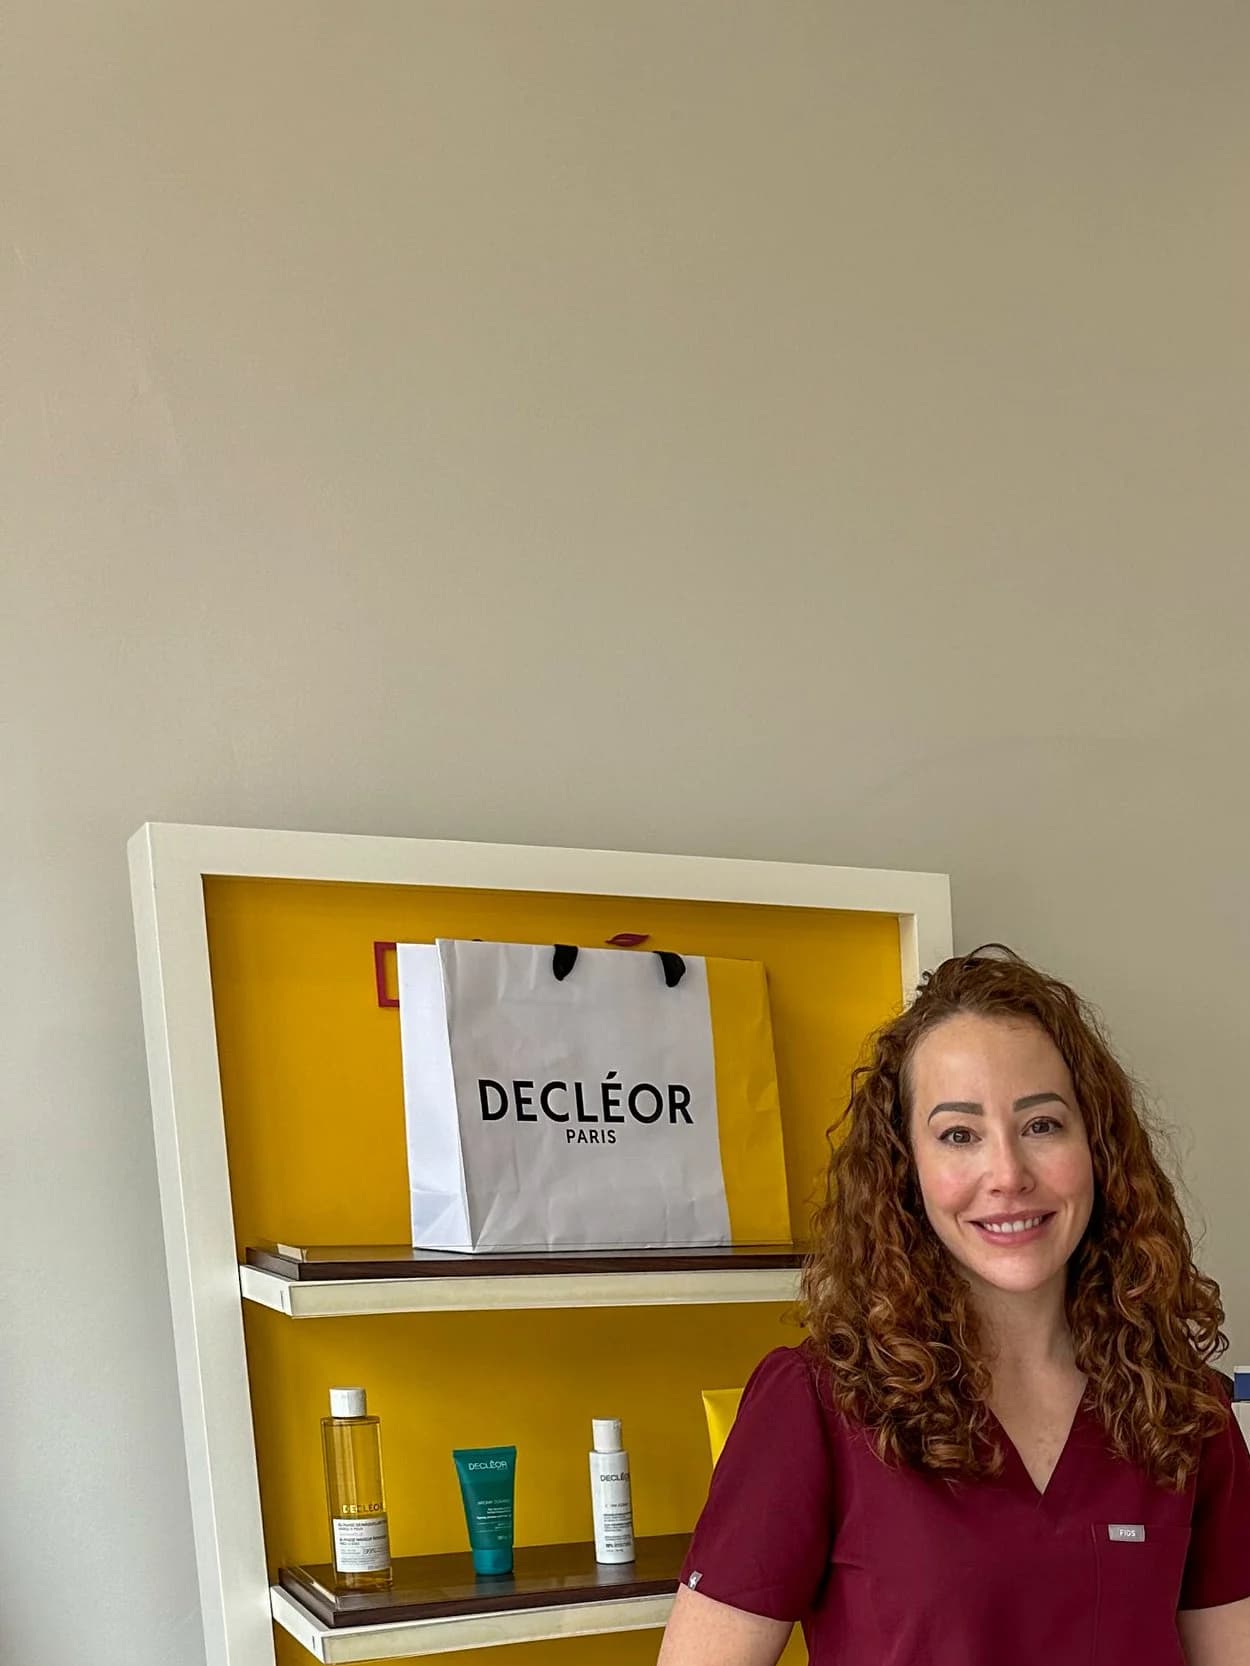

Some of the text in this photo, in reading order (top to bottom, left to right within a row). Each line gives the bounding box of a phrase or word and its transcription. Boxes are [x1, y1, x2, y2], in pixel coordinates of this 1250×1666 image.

[478, 1071, 694, 1125] DECLÉOR
[566, 1128, 617, 1144] PARIS
[600, 1472, 630, 1482] DECLÉO
